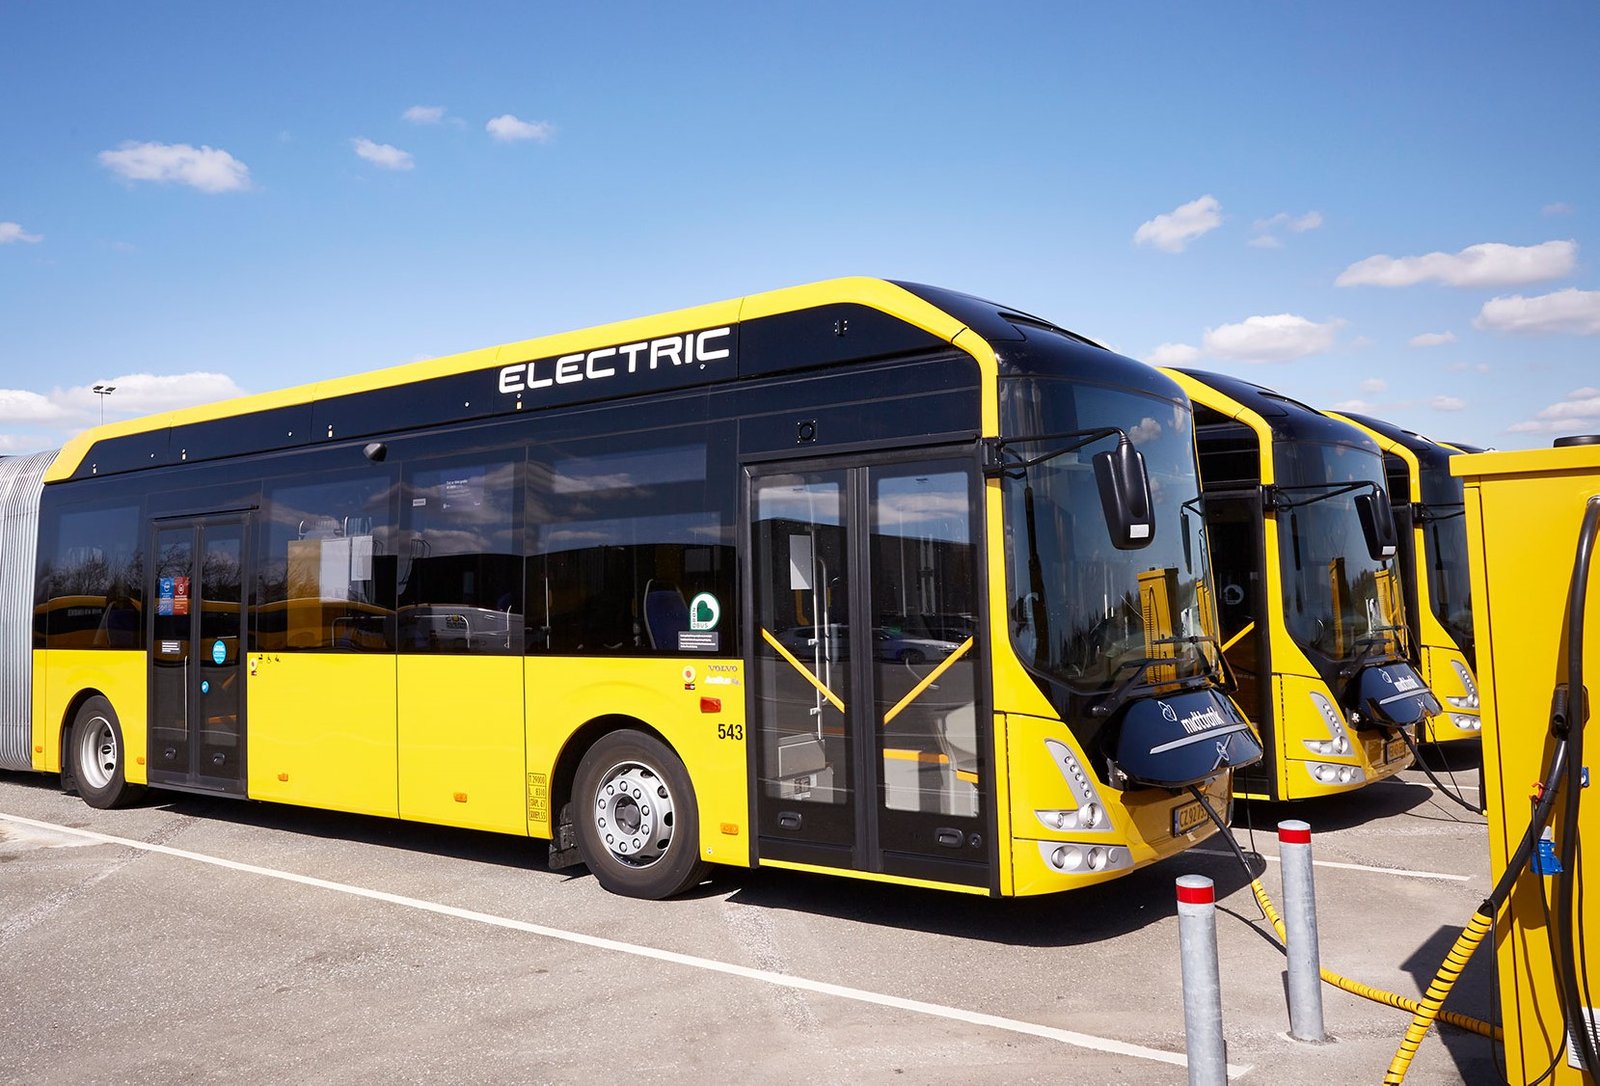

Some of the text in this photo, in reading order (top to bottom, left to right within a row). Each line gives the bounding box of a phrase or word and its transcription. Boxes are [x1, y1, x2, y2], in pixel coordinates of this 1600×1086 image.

[498, 327, 730, 394] ELECTRIC
[718, 723, 743, 740] 543
[1181, 706, 1225, 734] midttrafik
